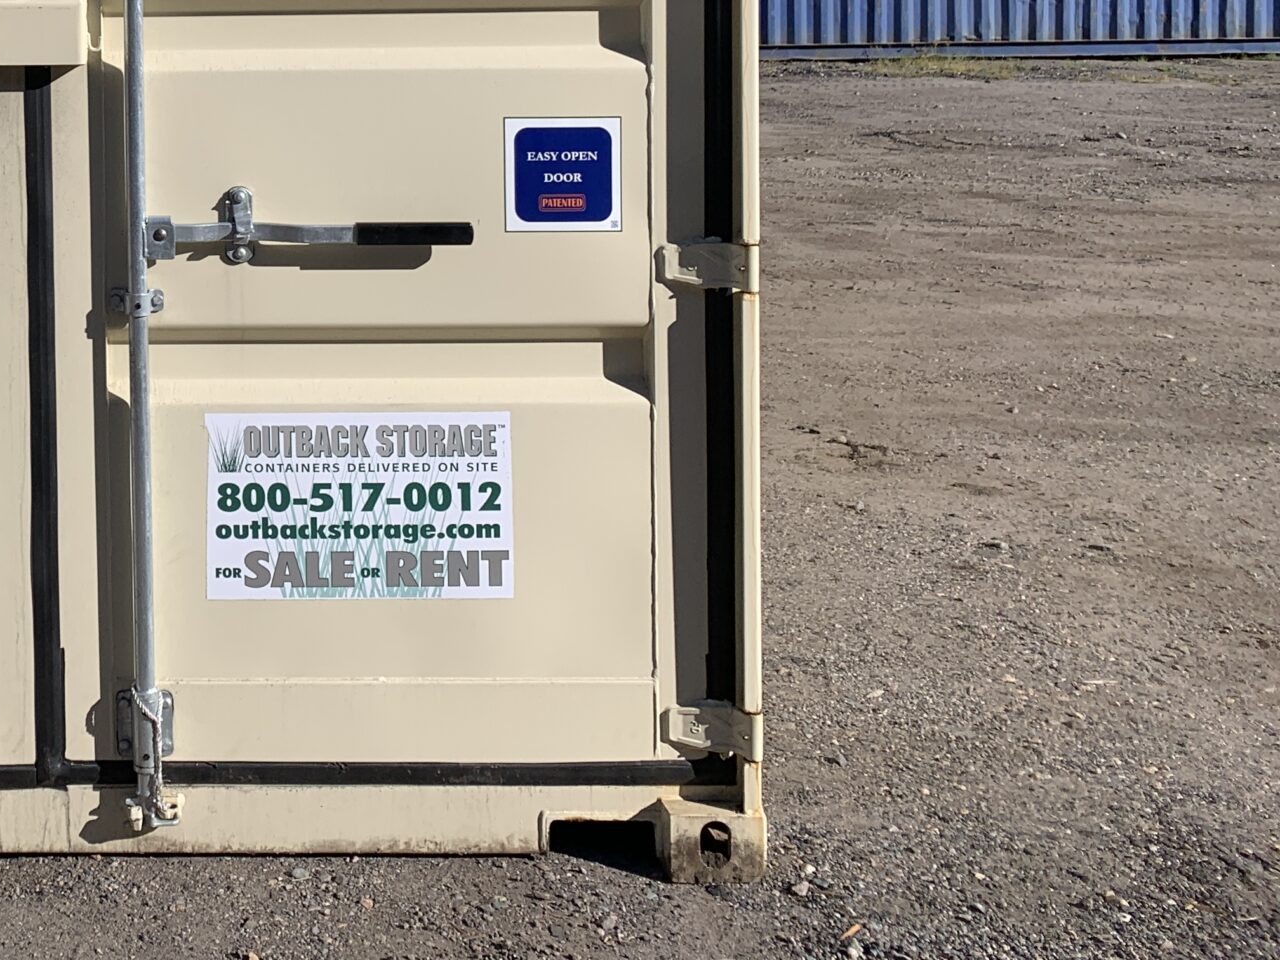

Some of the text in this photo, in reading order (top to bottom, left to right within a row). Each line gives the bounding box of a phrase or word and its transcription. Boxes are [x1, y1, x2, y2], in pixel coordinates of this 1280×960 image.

[527, 151, 598, 161] EASY OPEN
[543, 172, 583, 183] DOOR
[542, 198, 583, 207] PATENTED
[243, 424, 370, 459] OUTBACK
[375, 423, 498, 458] STORAGE
[244, 462, 499, 473] CONTAINERS DELIVERED ON SITE
[217, 481, 502, 513] 800-517-0012
[215, 517, 501, 544] outbackstorage.com
[215, 550, 510, 589] FOR SALE OR RENT
